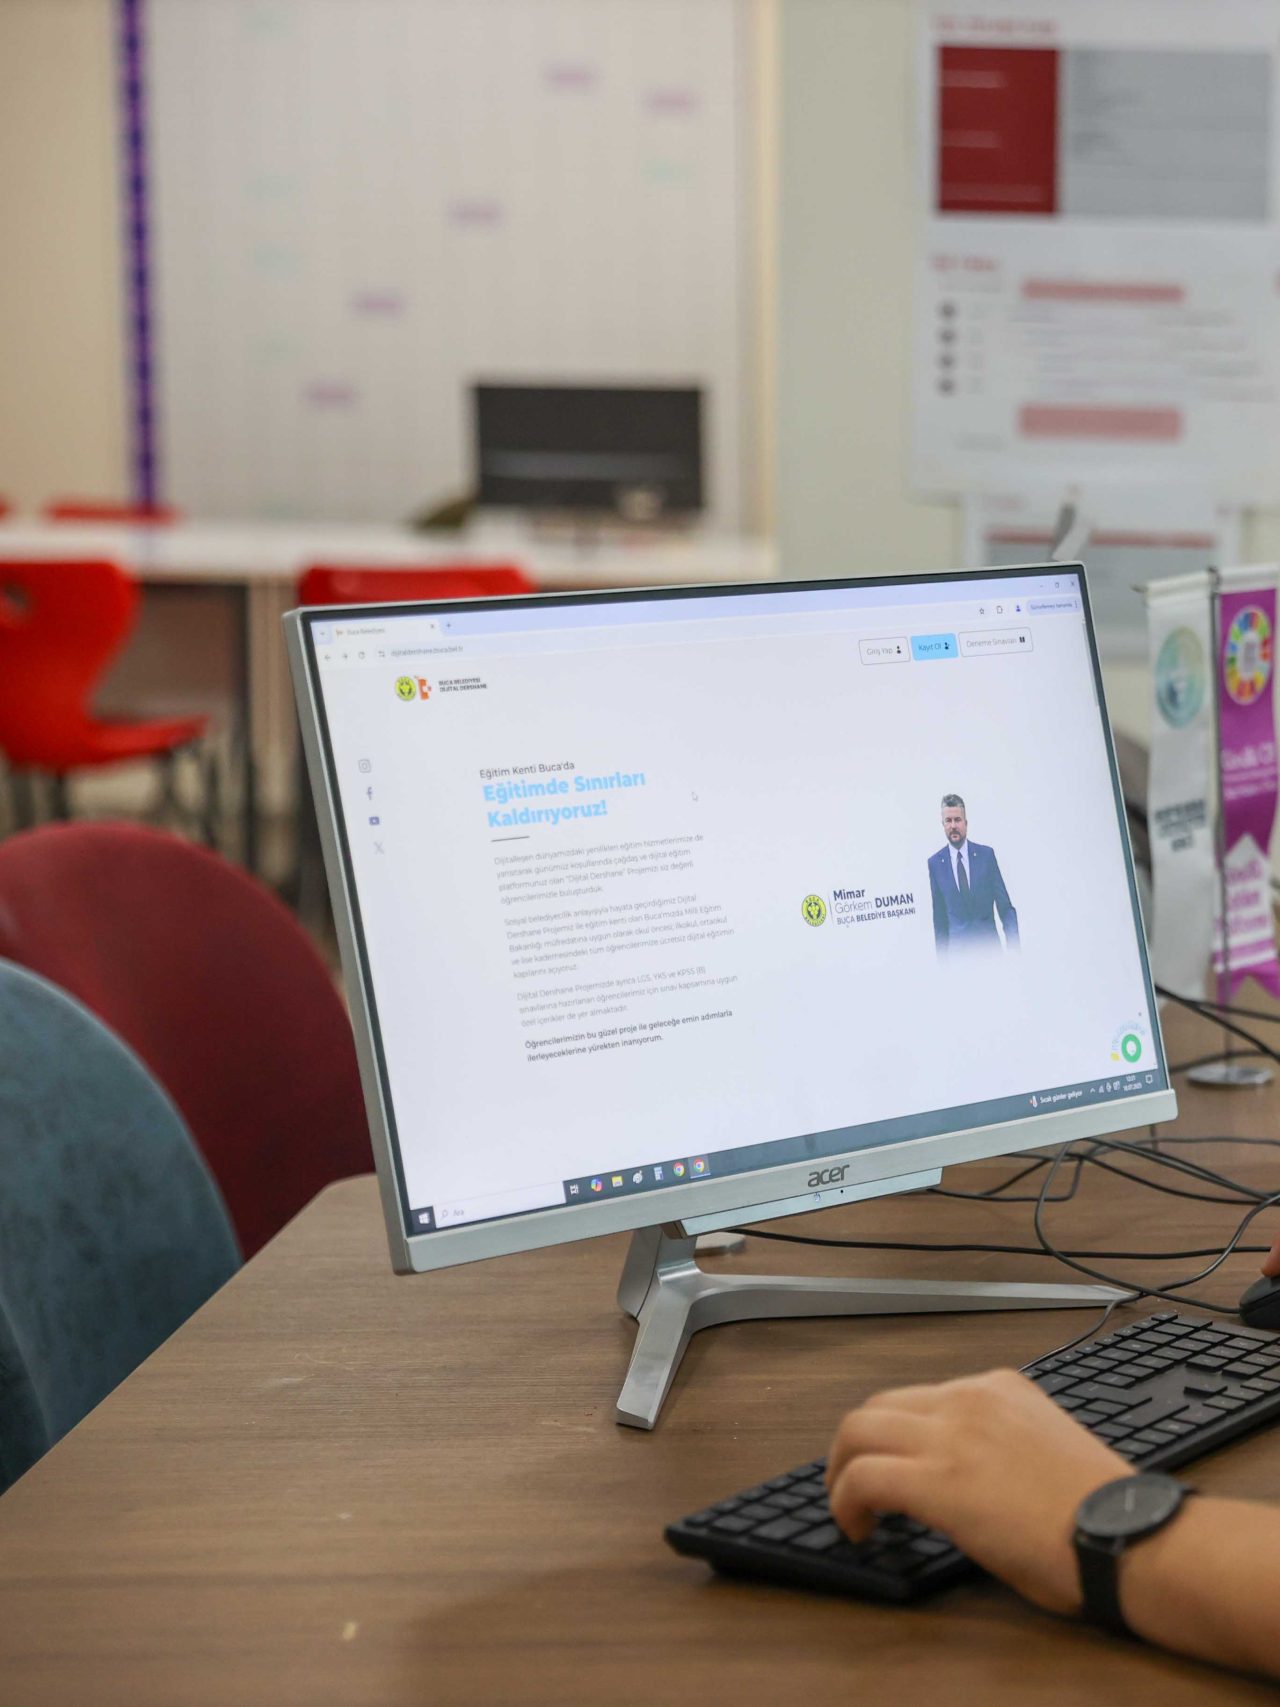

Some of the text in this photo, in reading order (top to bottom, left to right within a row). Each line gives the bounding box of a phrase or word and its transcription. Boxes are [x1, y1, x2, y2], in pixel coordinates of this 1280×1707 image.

[918, 644, 933, 652] Kayıt
[479, 761, 575, 780] Eğitim Kenti Buca'da
[482, 771, 647, 804] Eğitimde Sınırları
[486, 799, 608, 828] Kaldırıyoruz!
[668, 849, 691, 859] eğitim
[677, 894, 697, 904] Dijital
[833, 889, 866, 901] Mimar
[834, 893, 914, 914] Görkem DUMAN
[837, 915, 855, 925] BUCA
[856, 910, 886, 922] BELEDİYE
[887, 907, 916, 920] BAŞKANI
[677, 967, 695, 977] KPSS
[524, 1009, 733, 1050] Öğrencilerimizin bu güzel proje ile geleceğe emin adımlarla
[527, 1035, 665, 1062] ilerleyeceklerine yürekten inanıyorum.
[808, 1164, 850, 1188] acer
